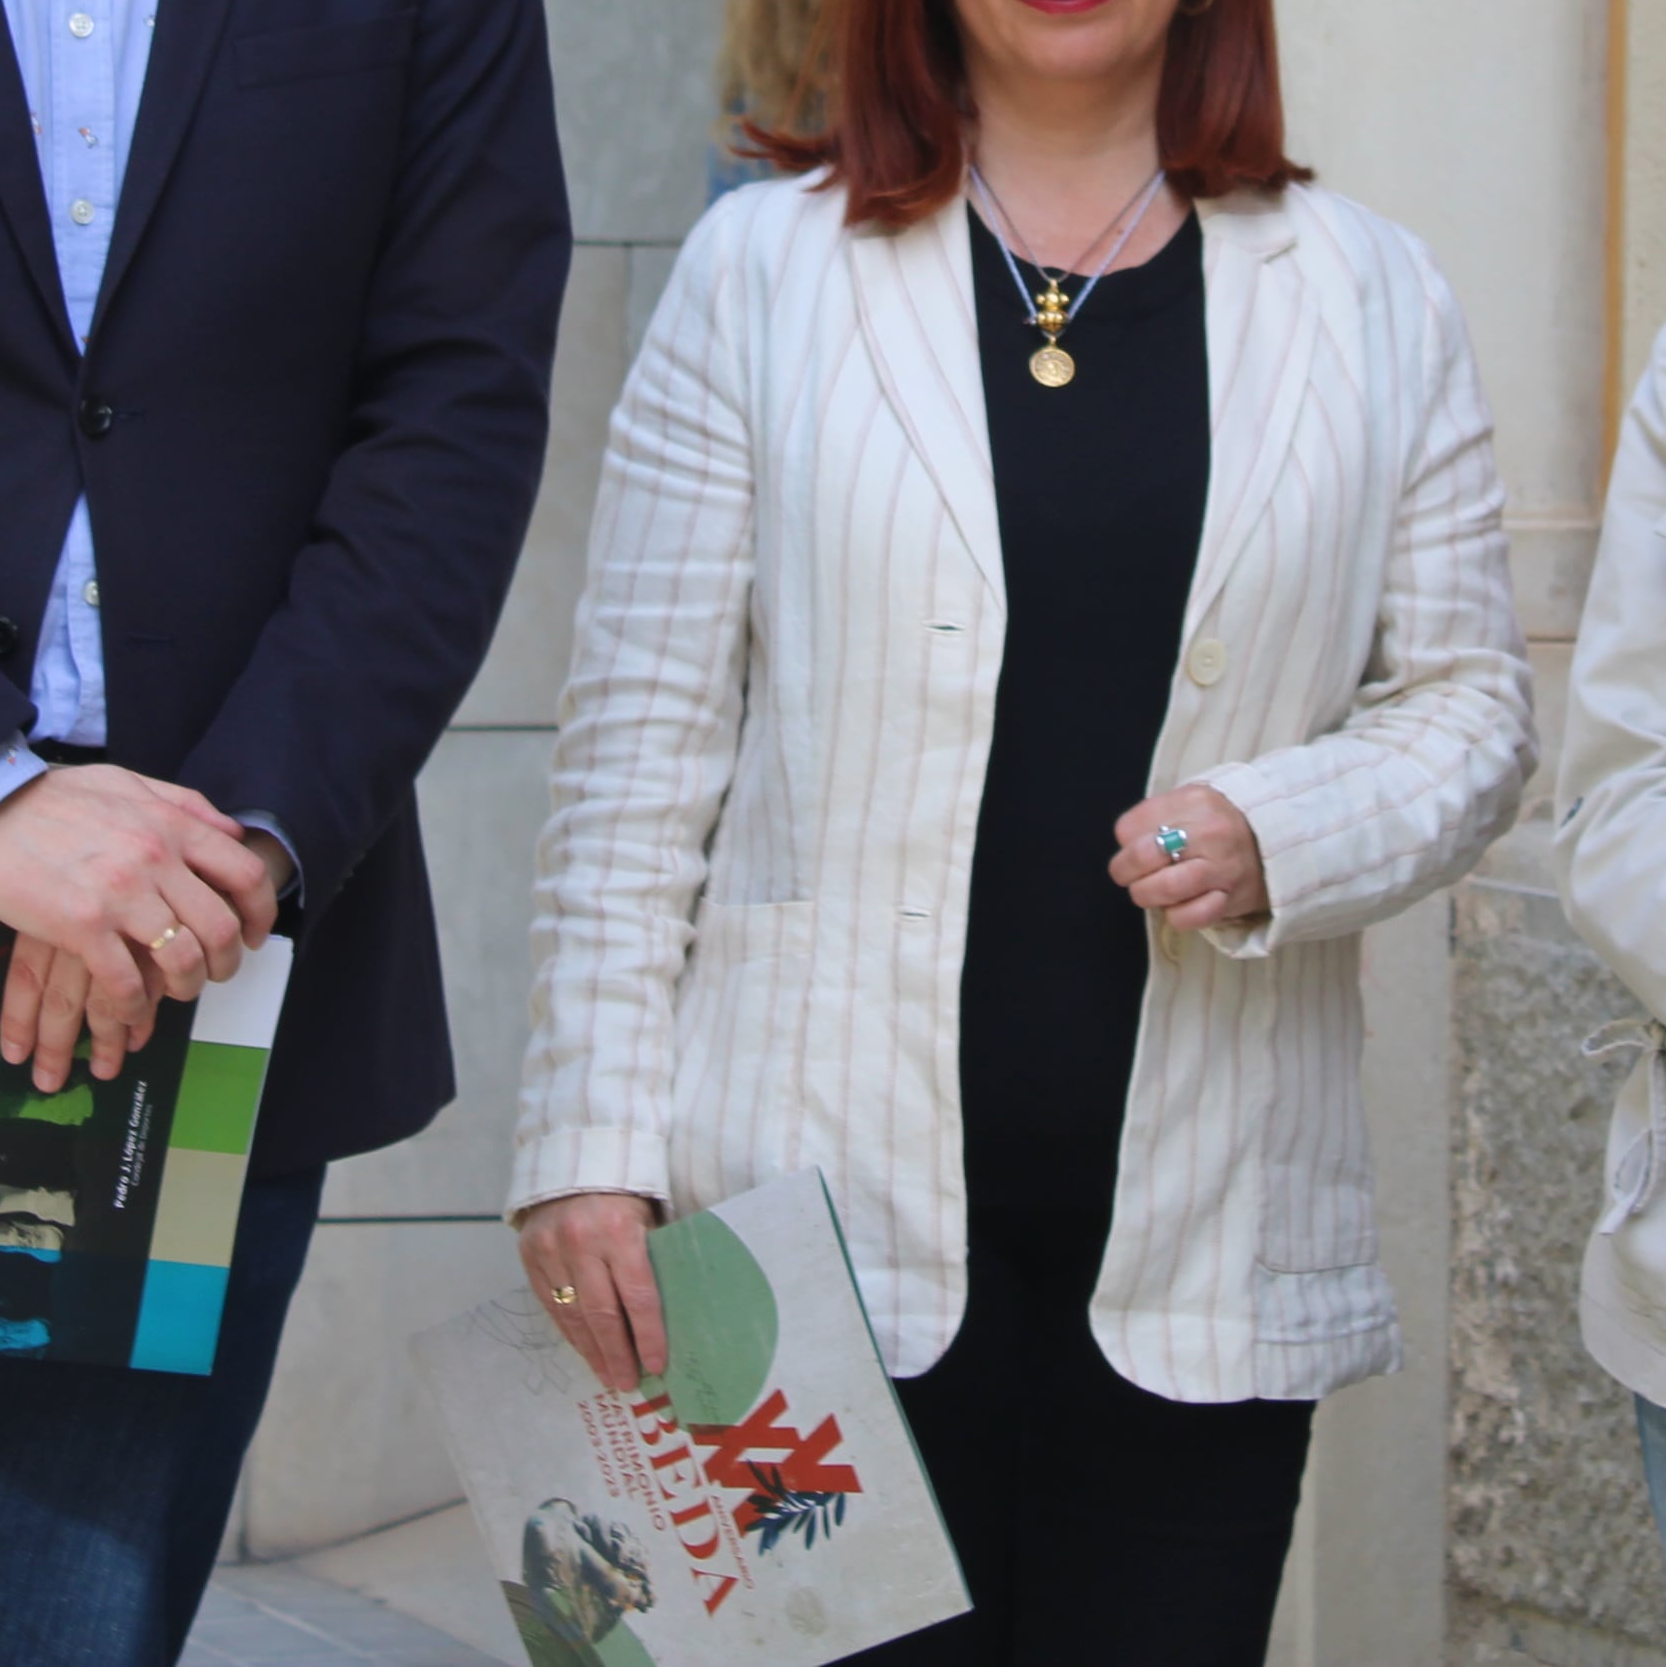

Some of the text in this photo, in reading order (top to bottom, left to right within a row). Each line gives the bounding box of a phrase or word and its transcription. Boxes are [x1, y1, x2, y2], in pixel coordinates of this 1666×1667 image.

[122, 1129, 137, 1161] López
[128, 1080, 147, 1127] González
[113, 1175, 129, 1208] Pedro
[593, 1394, 639, 1499] MUNDIAL
[607, 1387, 666, 1532] PATRIMONIO
[631, 1378, 739, 1617] BEDA
[710, 1495, 754, 1591] ANIVERSARIO
